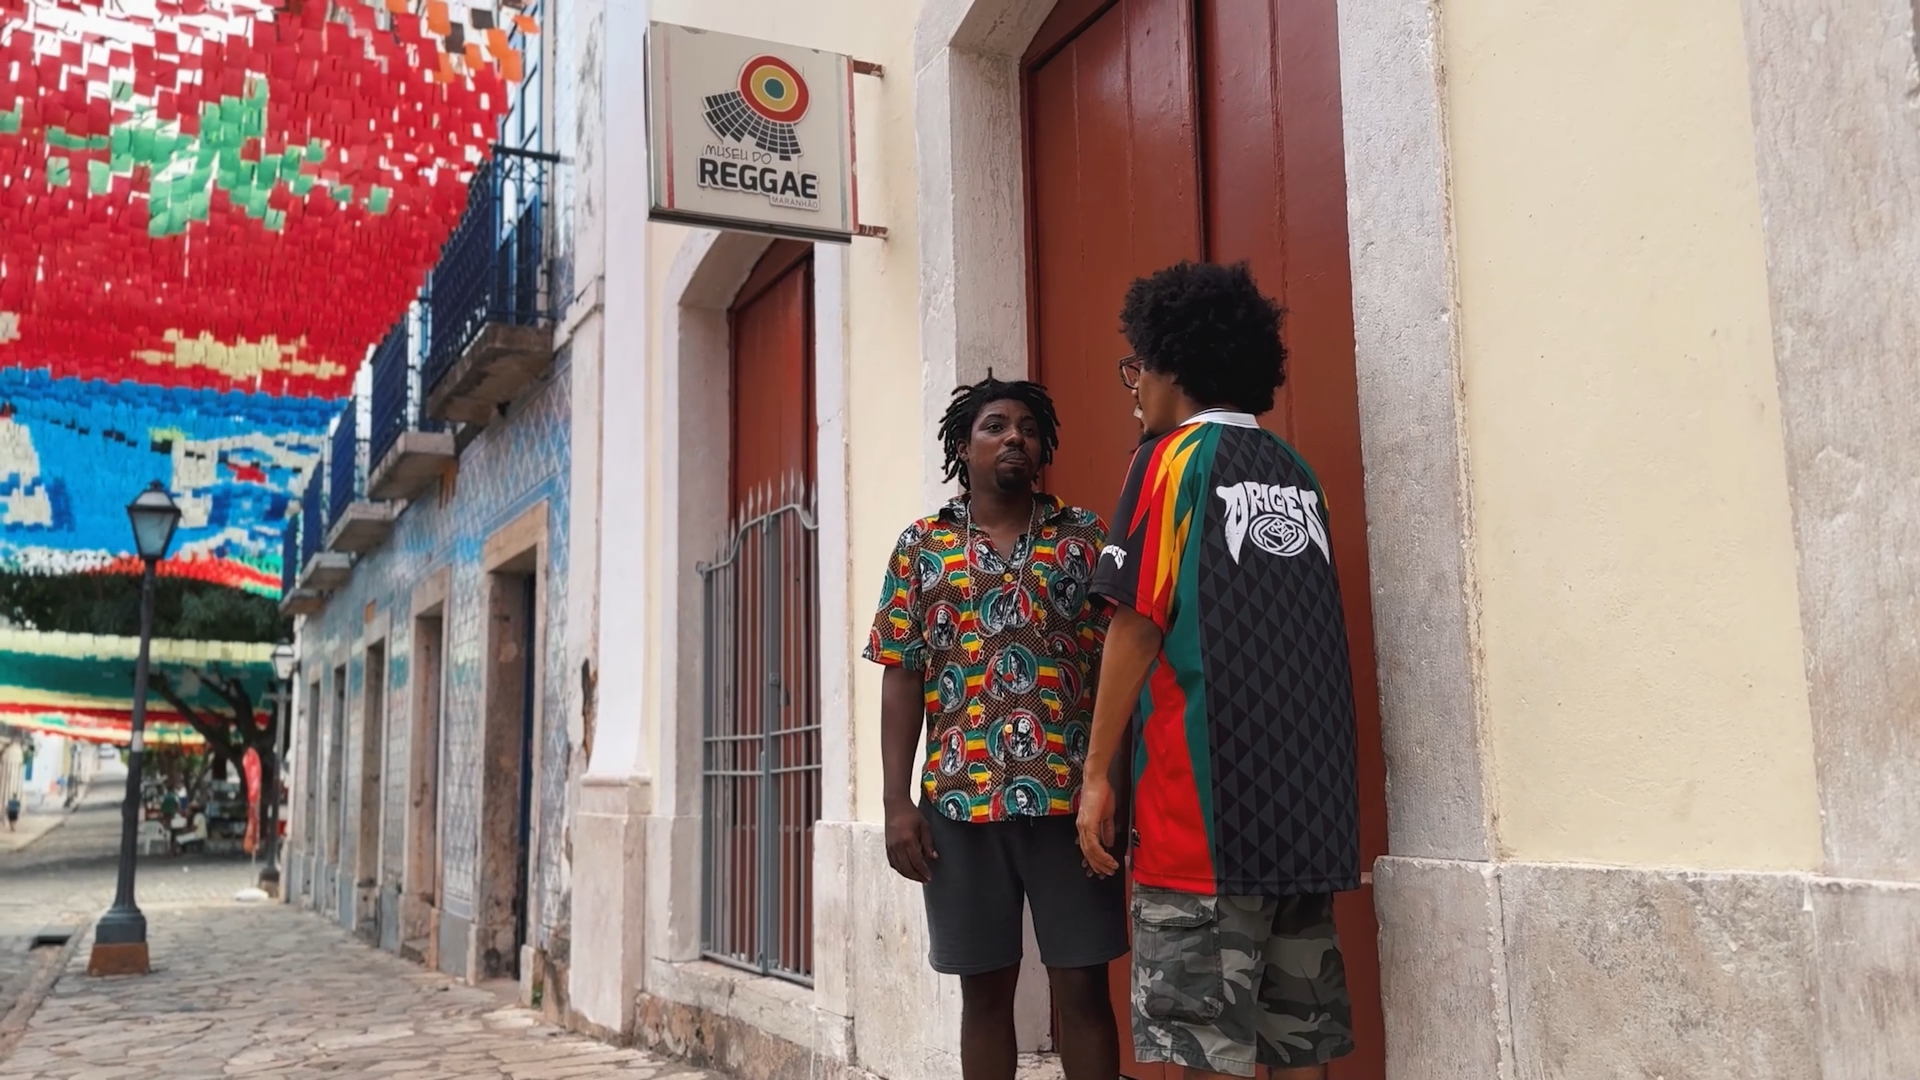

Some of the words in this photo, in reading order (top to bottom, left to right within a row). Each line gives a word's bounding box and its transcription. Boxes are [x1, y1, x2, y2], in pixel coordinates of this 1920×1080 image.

[705, 144, 748, 161] MUSEU
[752, 151, 772, 165] DO
[699, 157, 818, 199] REGGAE
[771, 195, 819, 209] MARANHÃO
